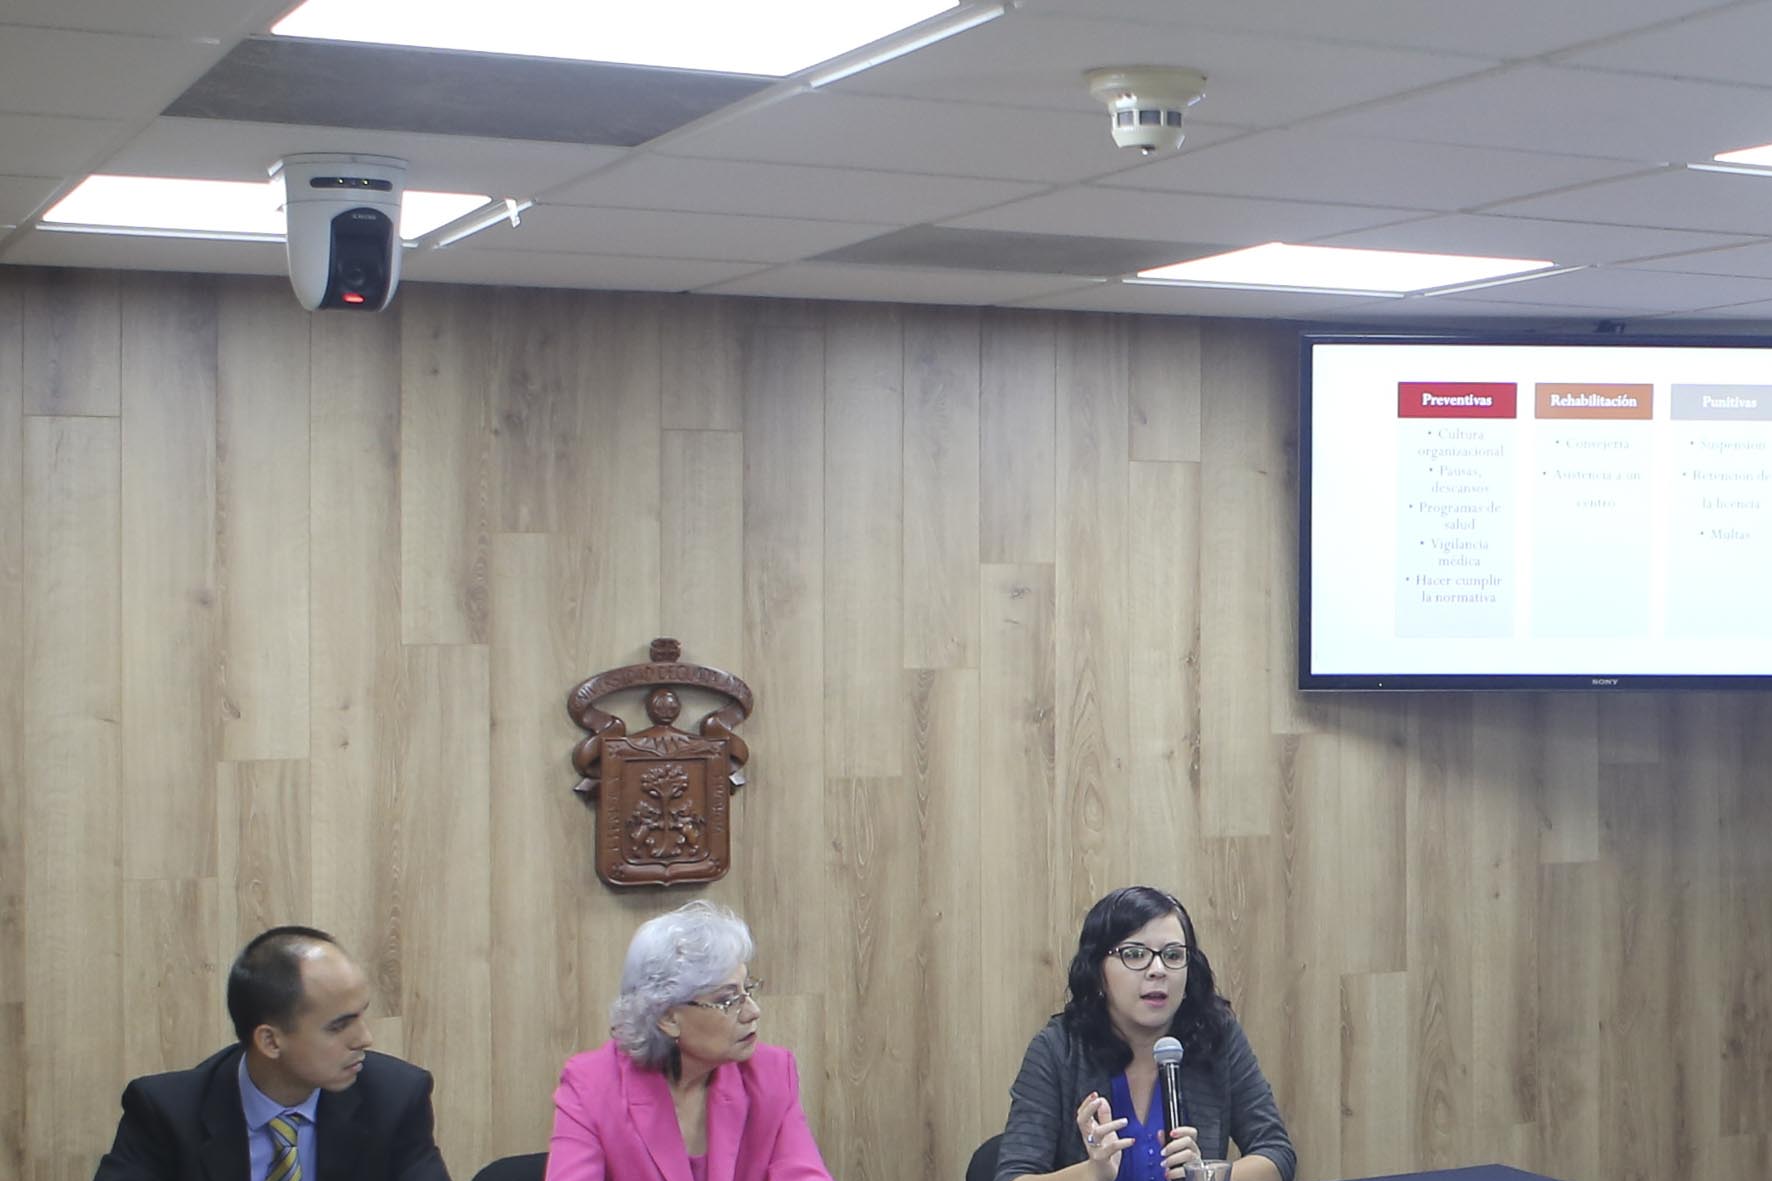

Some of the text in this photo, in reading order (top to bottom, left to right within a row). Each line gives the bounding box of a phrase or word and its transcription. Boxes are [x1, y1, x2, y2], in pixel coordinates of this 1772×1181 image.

[1422, 393, 1492, 406] Preventivas
[1550, 393, 1637, 407] Rehabilitación
[1702, 395, 1758, 408] Punitivas
[1438, 427, 1485, 440] Cultura
[1417, 444, 1504, 461] organizacional
[1419, 501, 1483, 517] Programas
[1444, 517, 1476, 530] salud
[1431, 537, 1489, 554] Vigilancia
[1416, 573, 1503, 590] Hacer cumplir
[1421, 590, 1496, 603] la normativa
[1592, 678, 1618, 686] SONY
